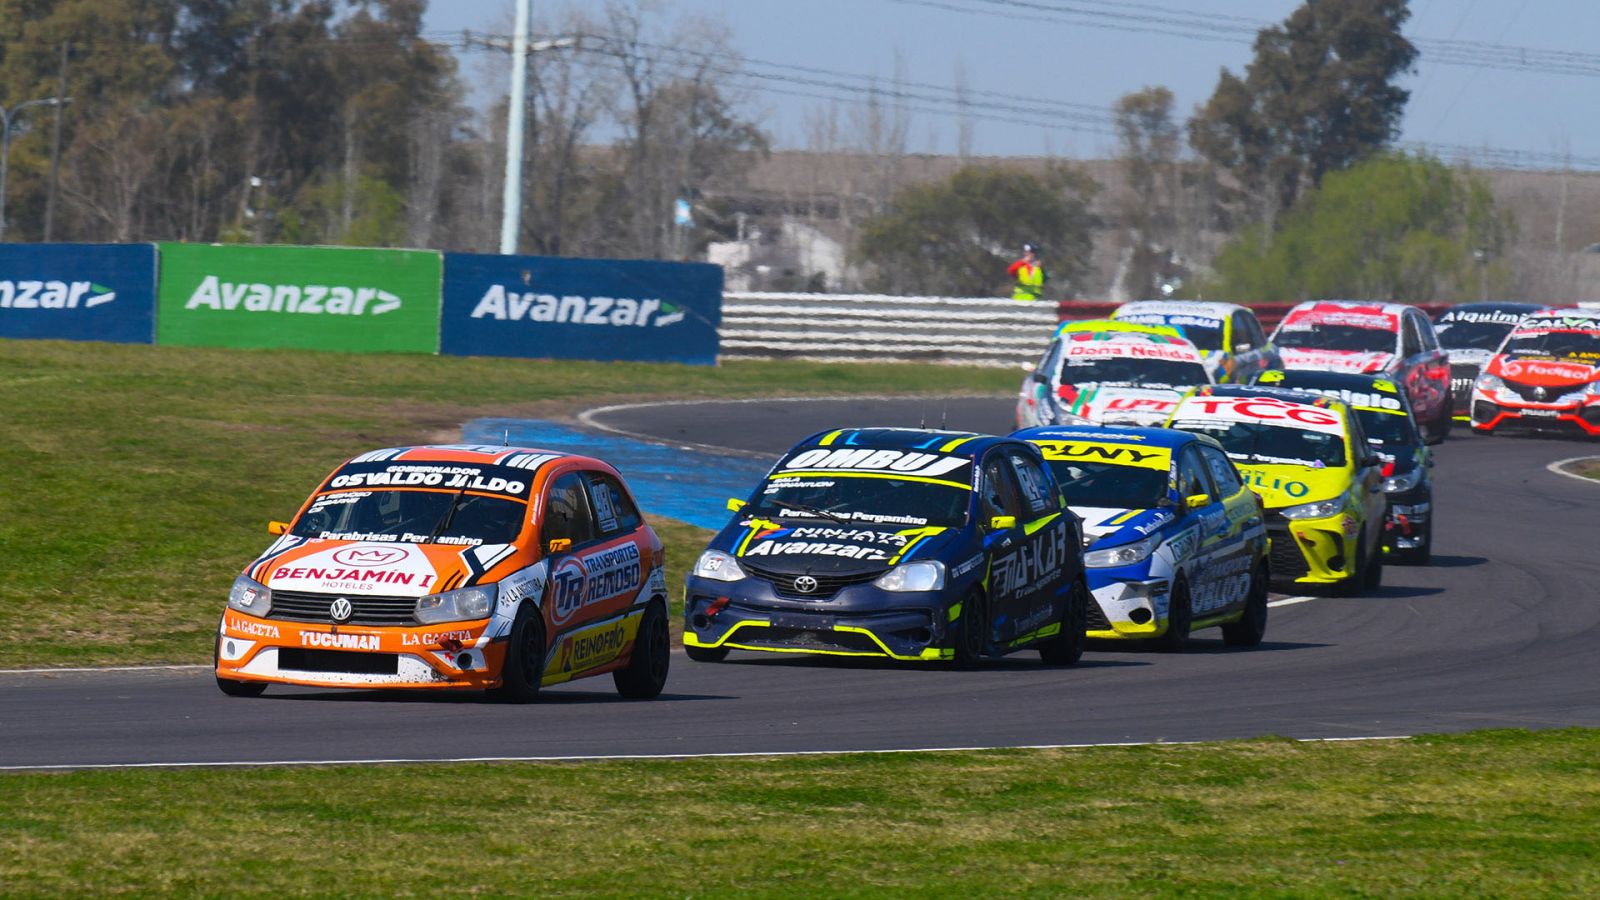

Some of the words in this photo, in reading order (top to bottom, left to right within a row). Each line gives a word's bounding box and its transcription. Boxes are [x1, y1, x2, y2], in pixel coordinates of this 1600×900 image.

[184, 275, 376, 315] Avanzar
[470, 284, 661, 327] Avanzar
[1191, 400, 1338, 425] TCG
[386, 465, 481, 476] GOBERNADOR
[785, 448, 971, 477] OMBU
[330, 471, 443, 488] OSVALDO
[445, 474, 525, 494] JALDO
[852, 511, 928, 525] Pergamino
[319, 531, 398, 542] Parabrisas
[400, 532, 483, 546] Peramino
[585, 544, 639, 574] TRANSPORTES
[746, 540, 872, 559] Avanzar
[272, 567, 415, 586] BENJAMÍN
[321, 581, 373, 591] HOTELES
[231, 617, 241, 631] LA
[241, 620, 281, 638] GACETA
[299, 630, 381, 650] TUCUMAN
[401, 632, 420, 646] LA
